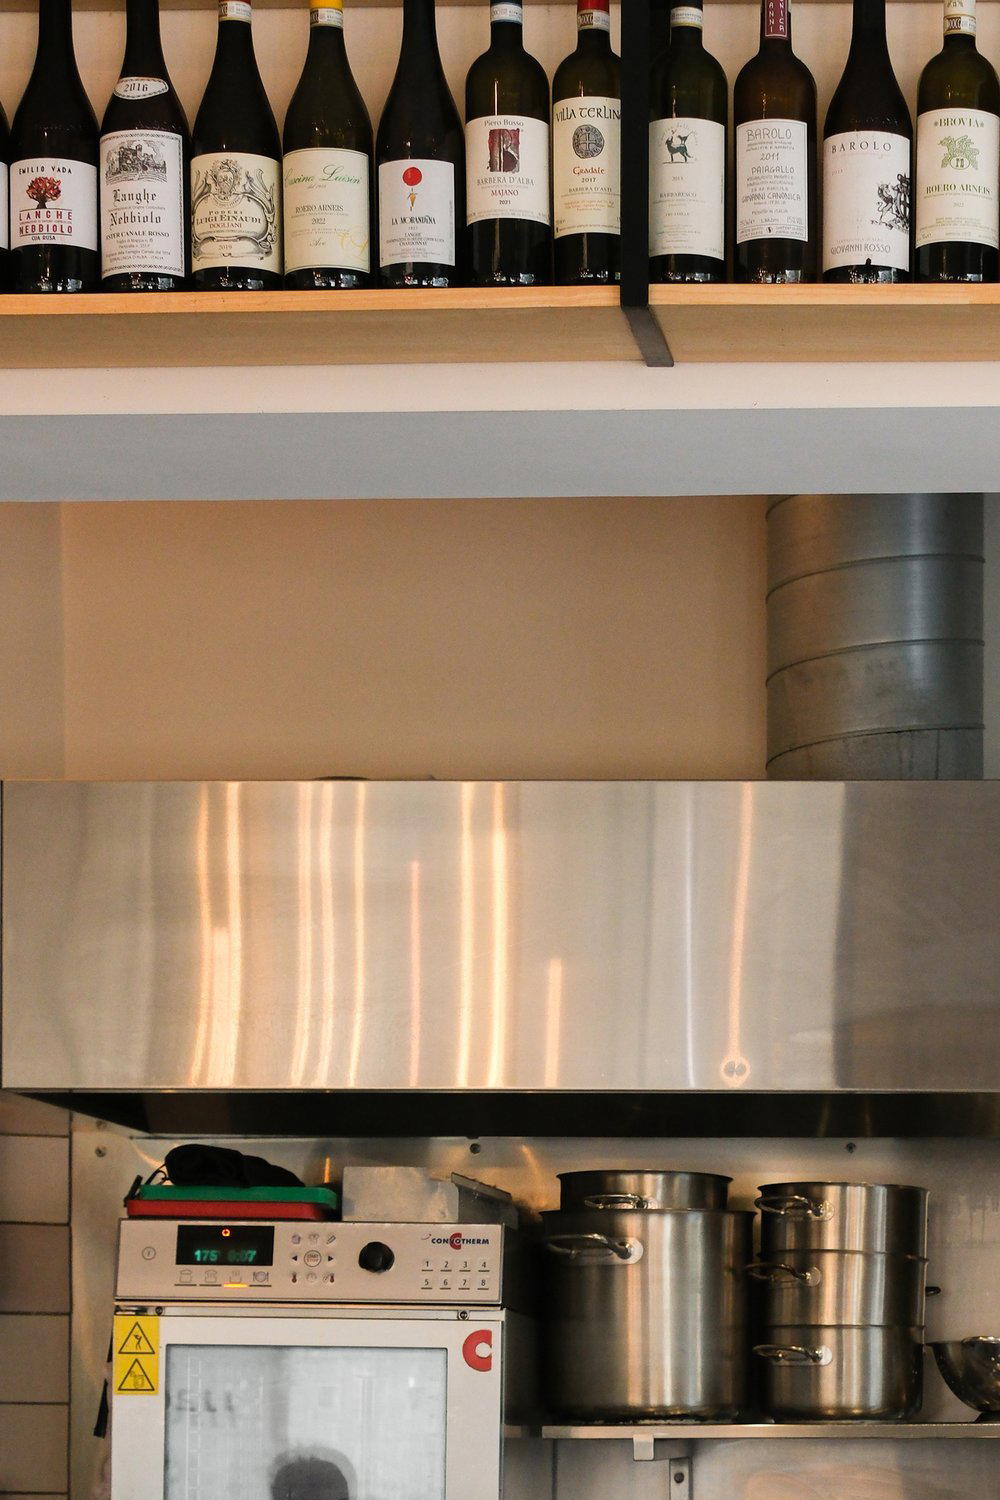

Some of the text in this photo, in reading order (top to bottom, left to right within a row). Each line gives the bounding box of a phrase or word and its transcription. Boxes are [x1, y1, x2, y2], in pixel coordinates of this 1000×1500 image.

[123, 83, 148, 92] 2016
[939, 116, 980, 128] BROVIA
[746, 127, 792, 142] BAROLO
[831, 140, 892, 154] BAROLO
[18, 165, 72, 175] EMILIO VADA
[926, 184, 991, 194] ROERO ARNEIS
[113, 188, 157, 205] Langhe
[19, 210, 73, 221] LANGHE
[109, 211, 161, 227] Nebbiolo
[196, 214, 261, 225] LUIGI EINAUDI
[19, 224, 73, 235] NEBBIOLO
[431, 1236, 490, 1246] CONVOTHERM
[194, 1248, 219, 1262] 175
